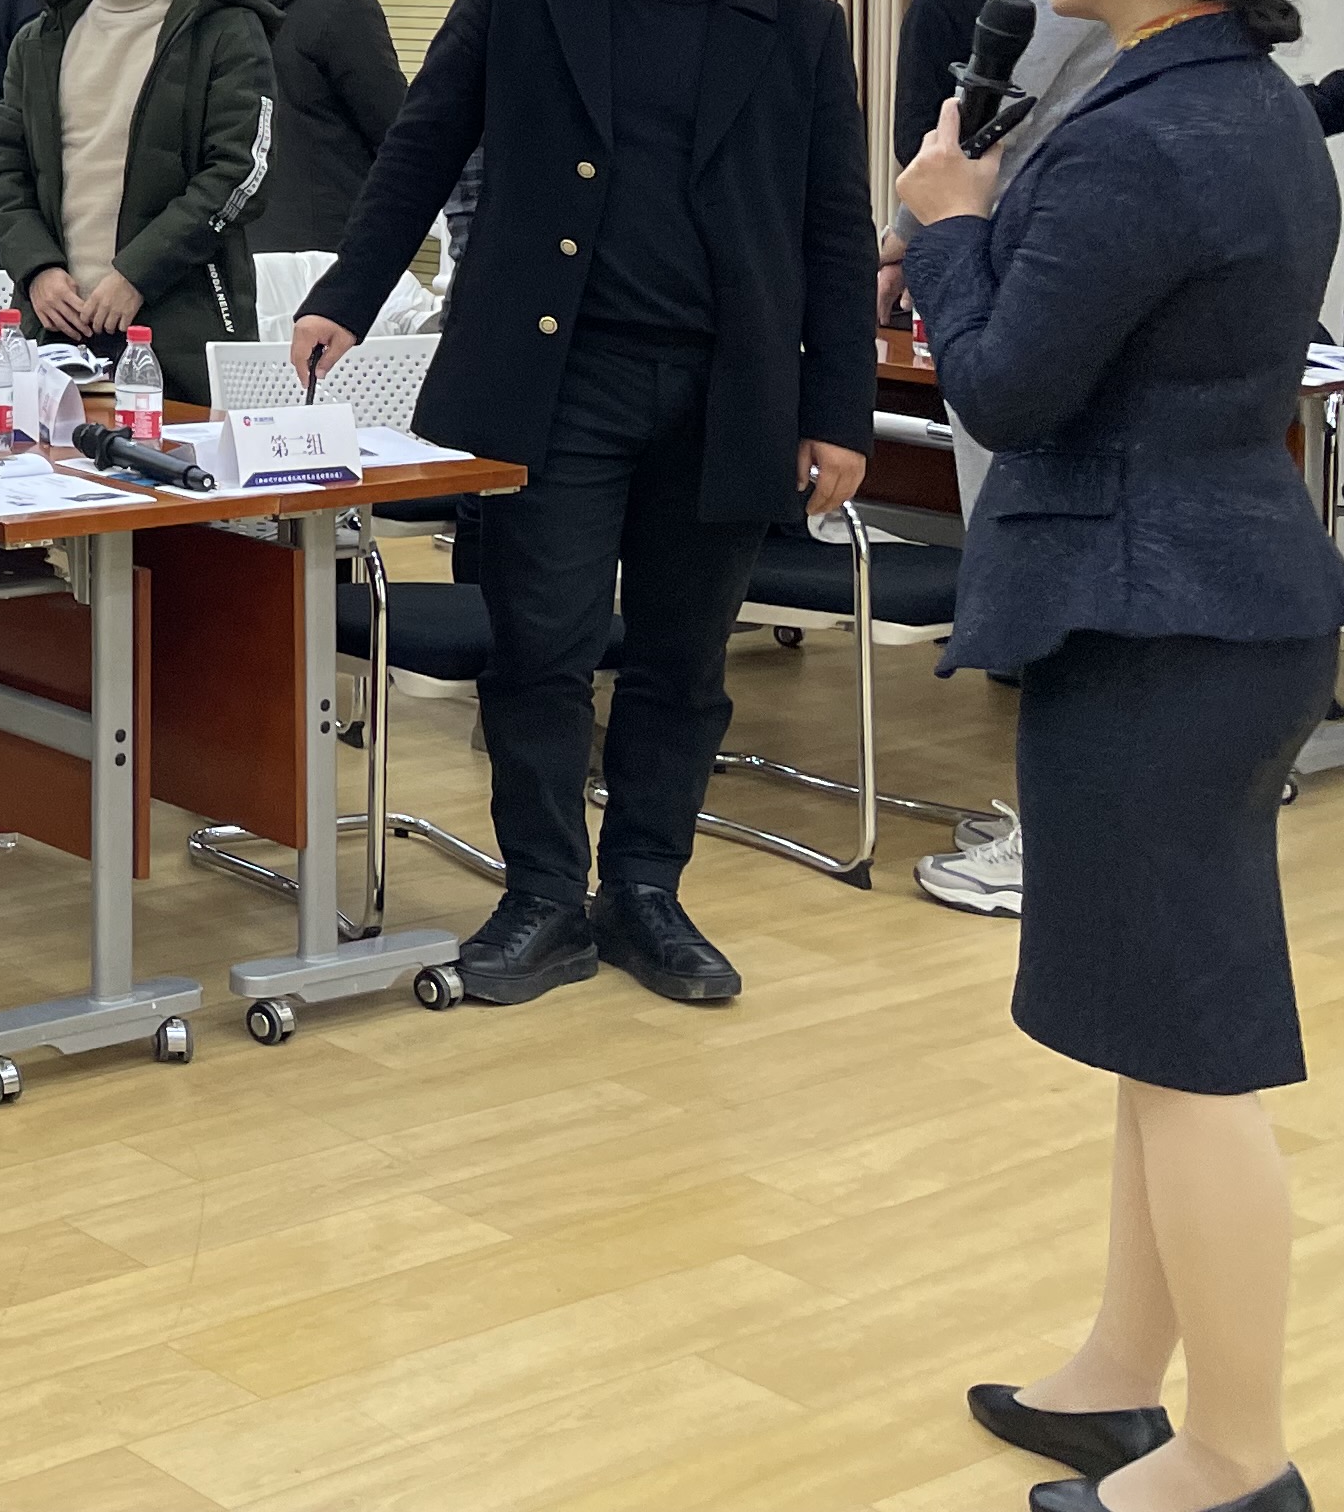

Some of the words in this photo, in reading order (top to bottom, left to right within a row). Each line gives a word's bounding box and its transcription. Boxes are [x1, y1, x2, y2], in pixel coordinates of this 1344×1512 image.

[216, 293, 235, 333] NELLAV
[270, 433, 326, 458] 第二组
